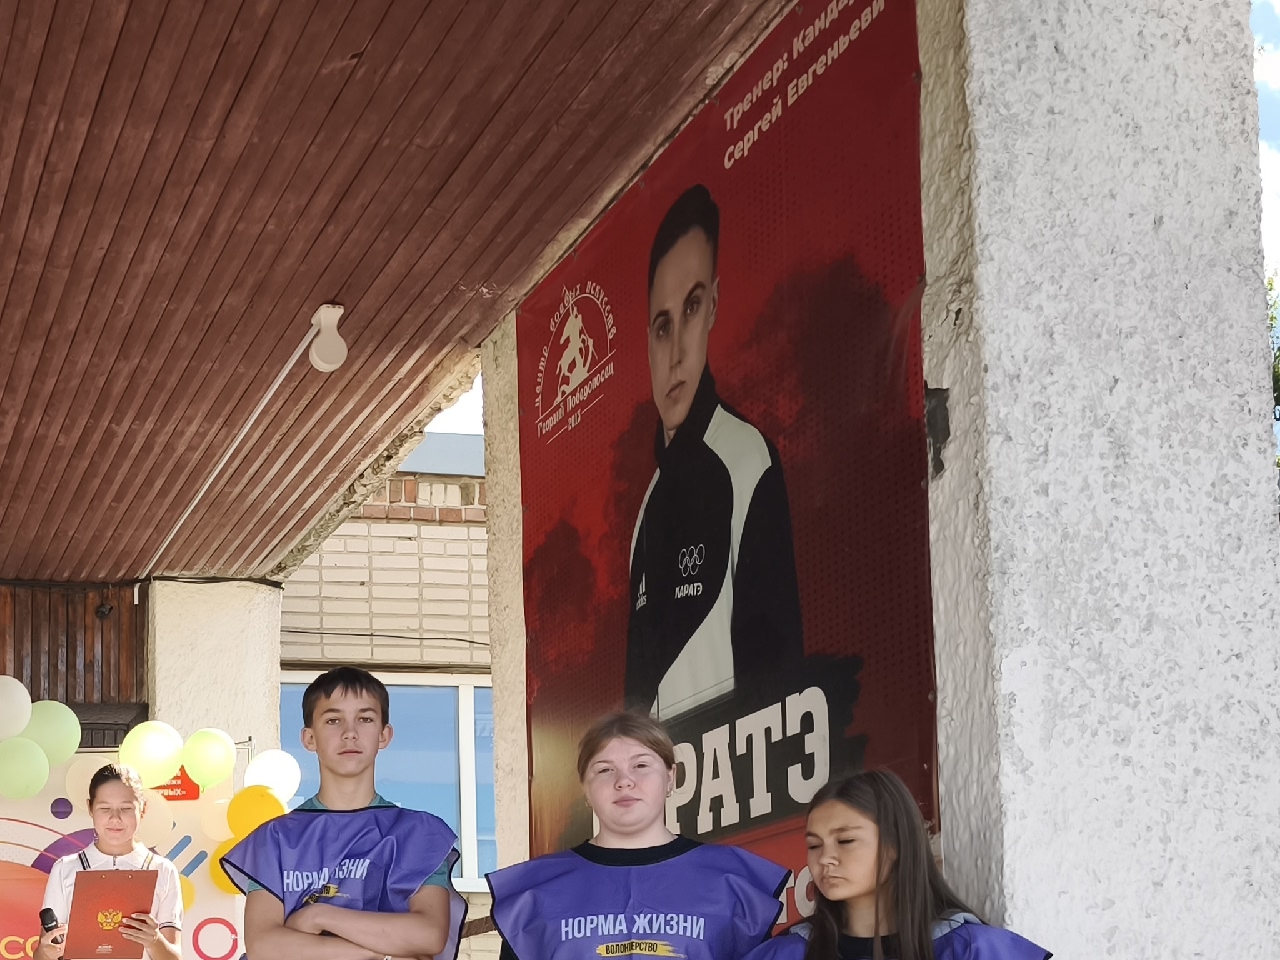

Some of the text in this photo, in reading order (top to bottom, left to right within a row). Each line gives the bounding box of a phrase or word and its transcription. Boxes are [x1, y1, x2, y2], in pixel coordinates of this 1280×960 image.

[724, 0, 885, 170] Сергей Евгеньеви
[724, 52, 789, 132] Тренер:
[674, 582, 703, 599] КАРАТЭ
[665, 686, 830, 835] РАТЭ
[561, 913, 705, 941] НОРМА ЖИЗНИ
